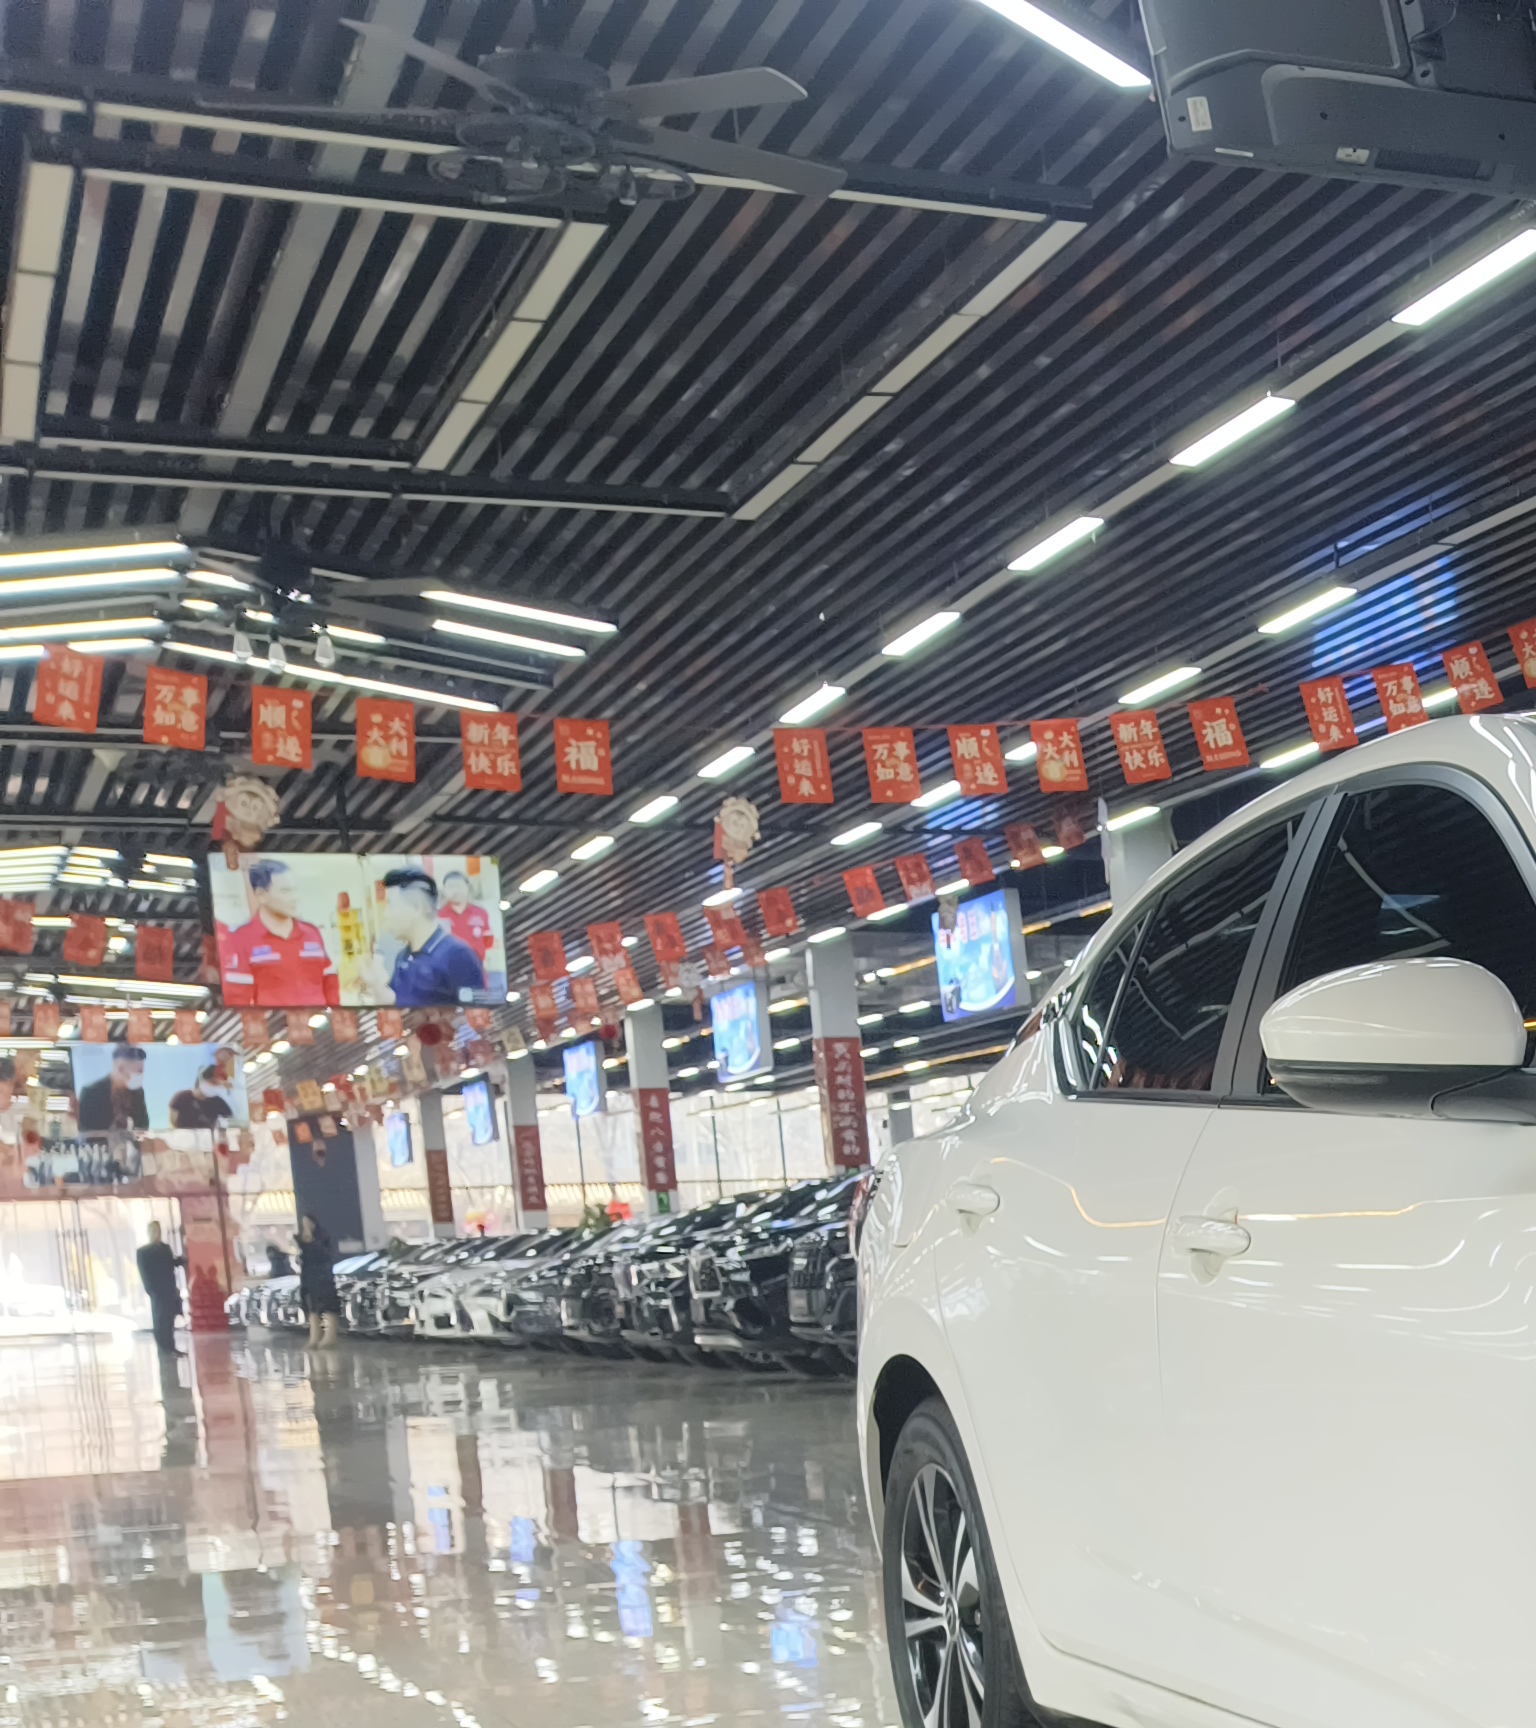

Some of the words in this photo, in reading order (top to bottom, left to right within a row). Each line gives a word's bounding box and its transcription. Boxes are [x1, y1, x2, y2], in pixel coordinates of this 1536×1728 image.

[1116, 718, 1160, 744] 新年
[1201, 717, 1235, 751] 福
[563, 737, 599, 772] 福
[1122, 745, 1167, 772] 快乐
